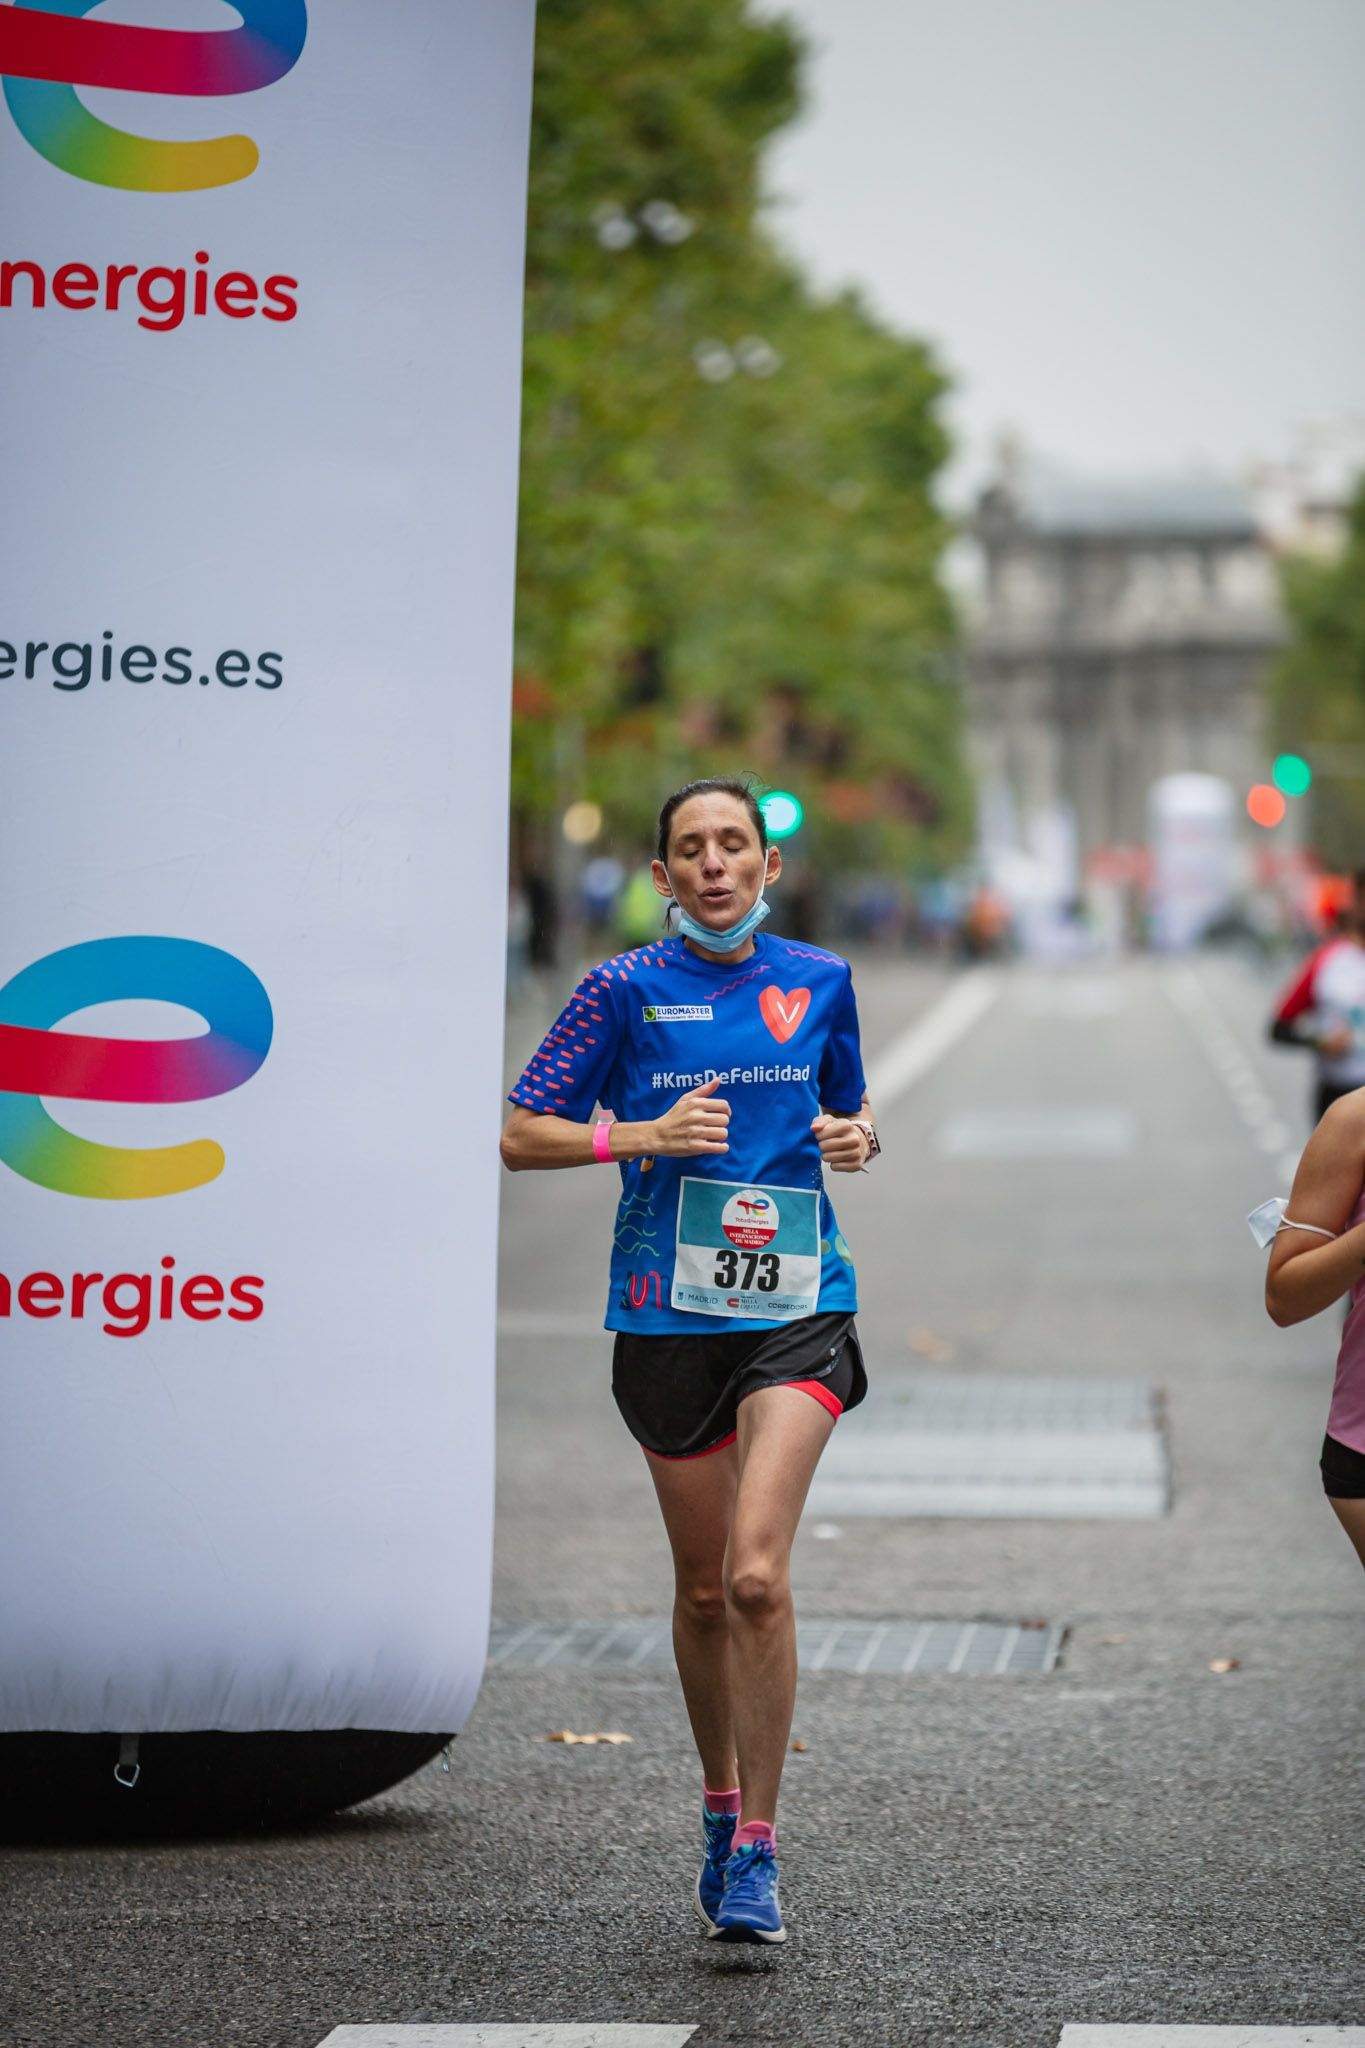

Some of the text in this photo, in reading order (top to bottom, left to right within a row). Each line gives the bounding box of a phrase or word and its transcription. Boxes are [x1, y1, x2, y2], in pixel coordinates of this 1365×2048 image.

[0, 251, 299, 331] nergies
[657, 1007, 711, 1015] EUROMASTER
[652, 1065, 811, 1089] #KmsDeFelicidad
[714, 1249, 781, 1292] 373
[0, 1255, 265, 1338] ergies
[688, 1293, 719, 1305] MADRID
